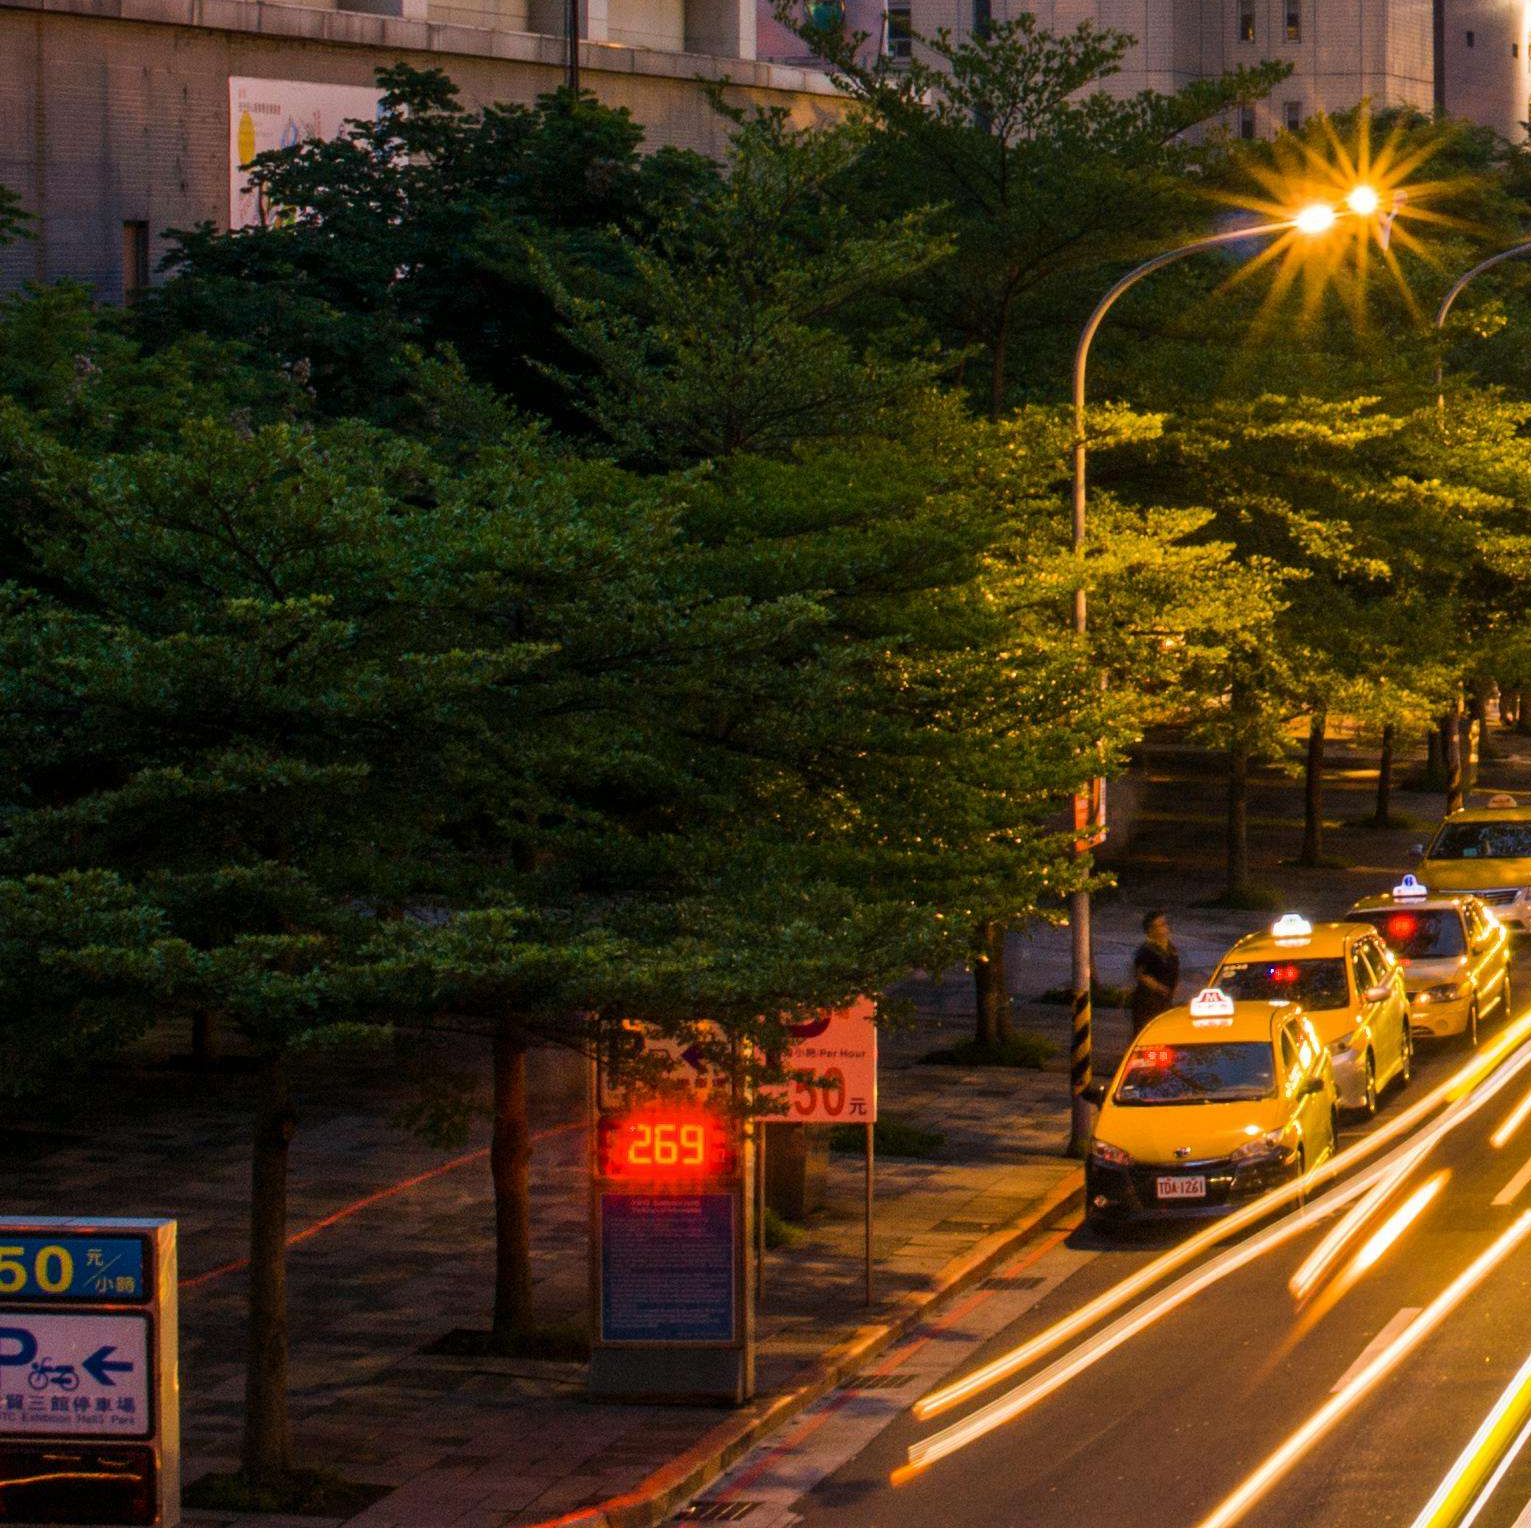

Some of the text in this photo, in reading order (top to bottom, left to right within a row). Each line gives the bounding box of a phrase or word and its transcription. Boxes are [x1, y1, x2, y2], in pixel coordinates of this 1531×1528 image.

[840, 1048, 865, 1058] Hour
[795, 1067, 867, 1116] 50 元
[629, 1124, 704, 1164] 269
[0, 1245, 104, 1294] 50 元
[0, 1394, 136, 1413] 貿三館停車場
